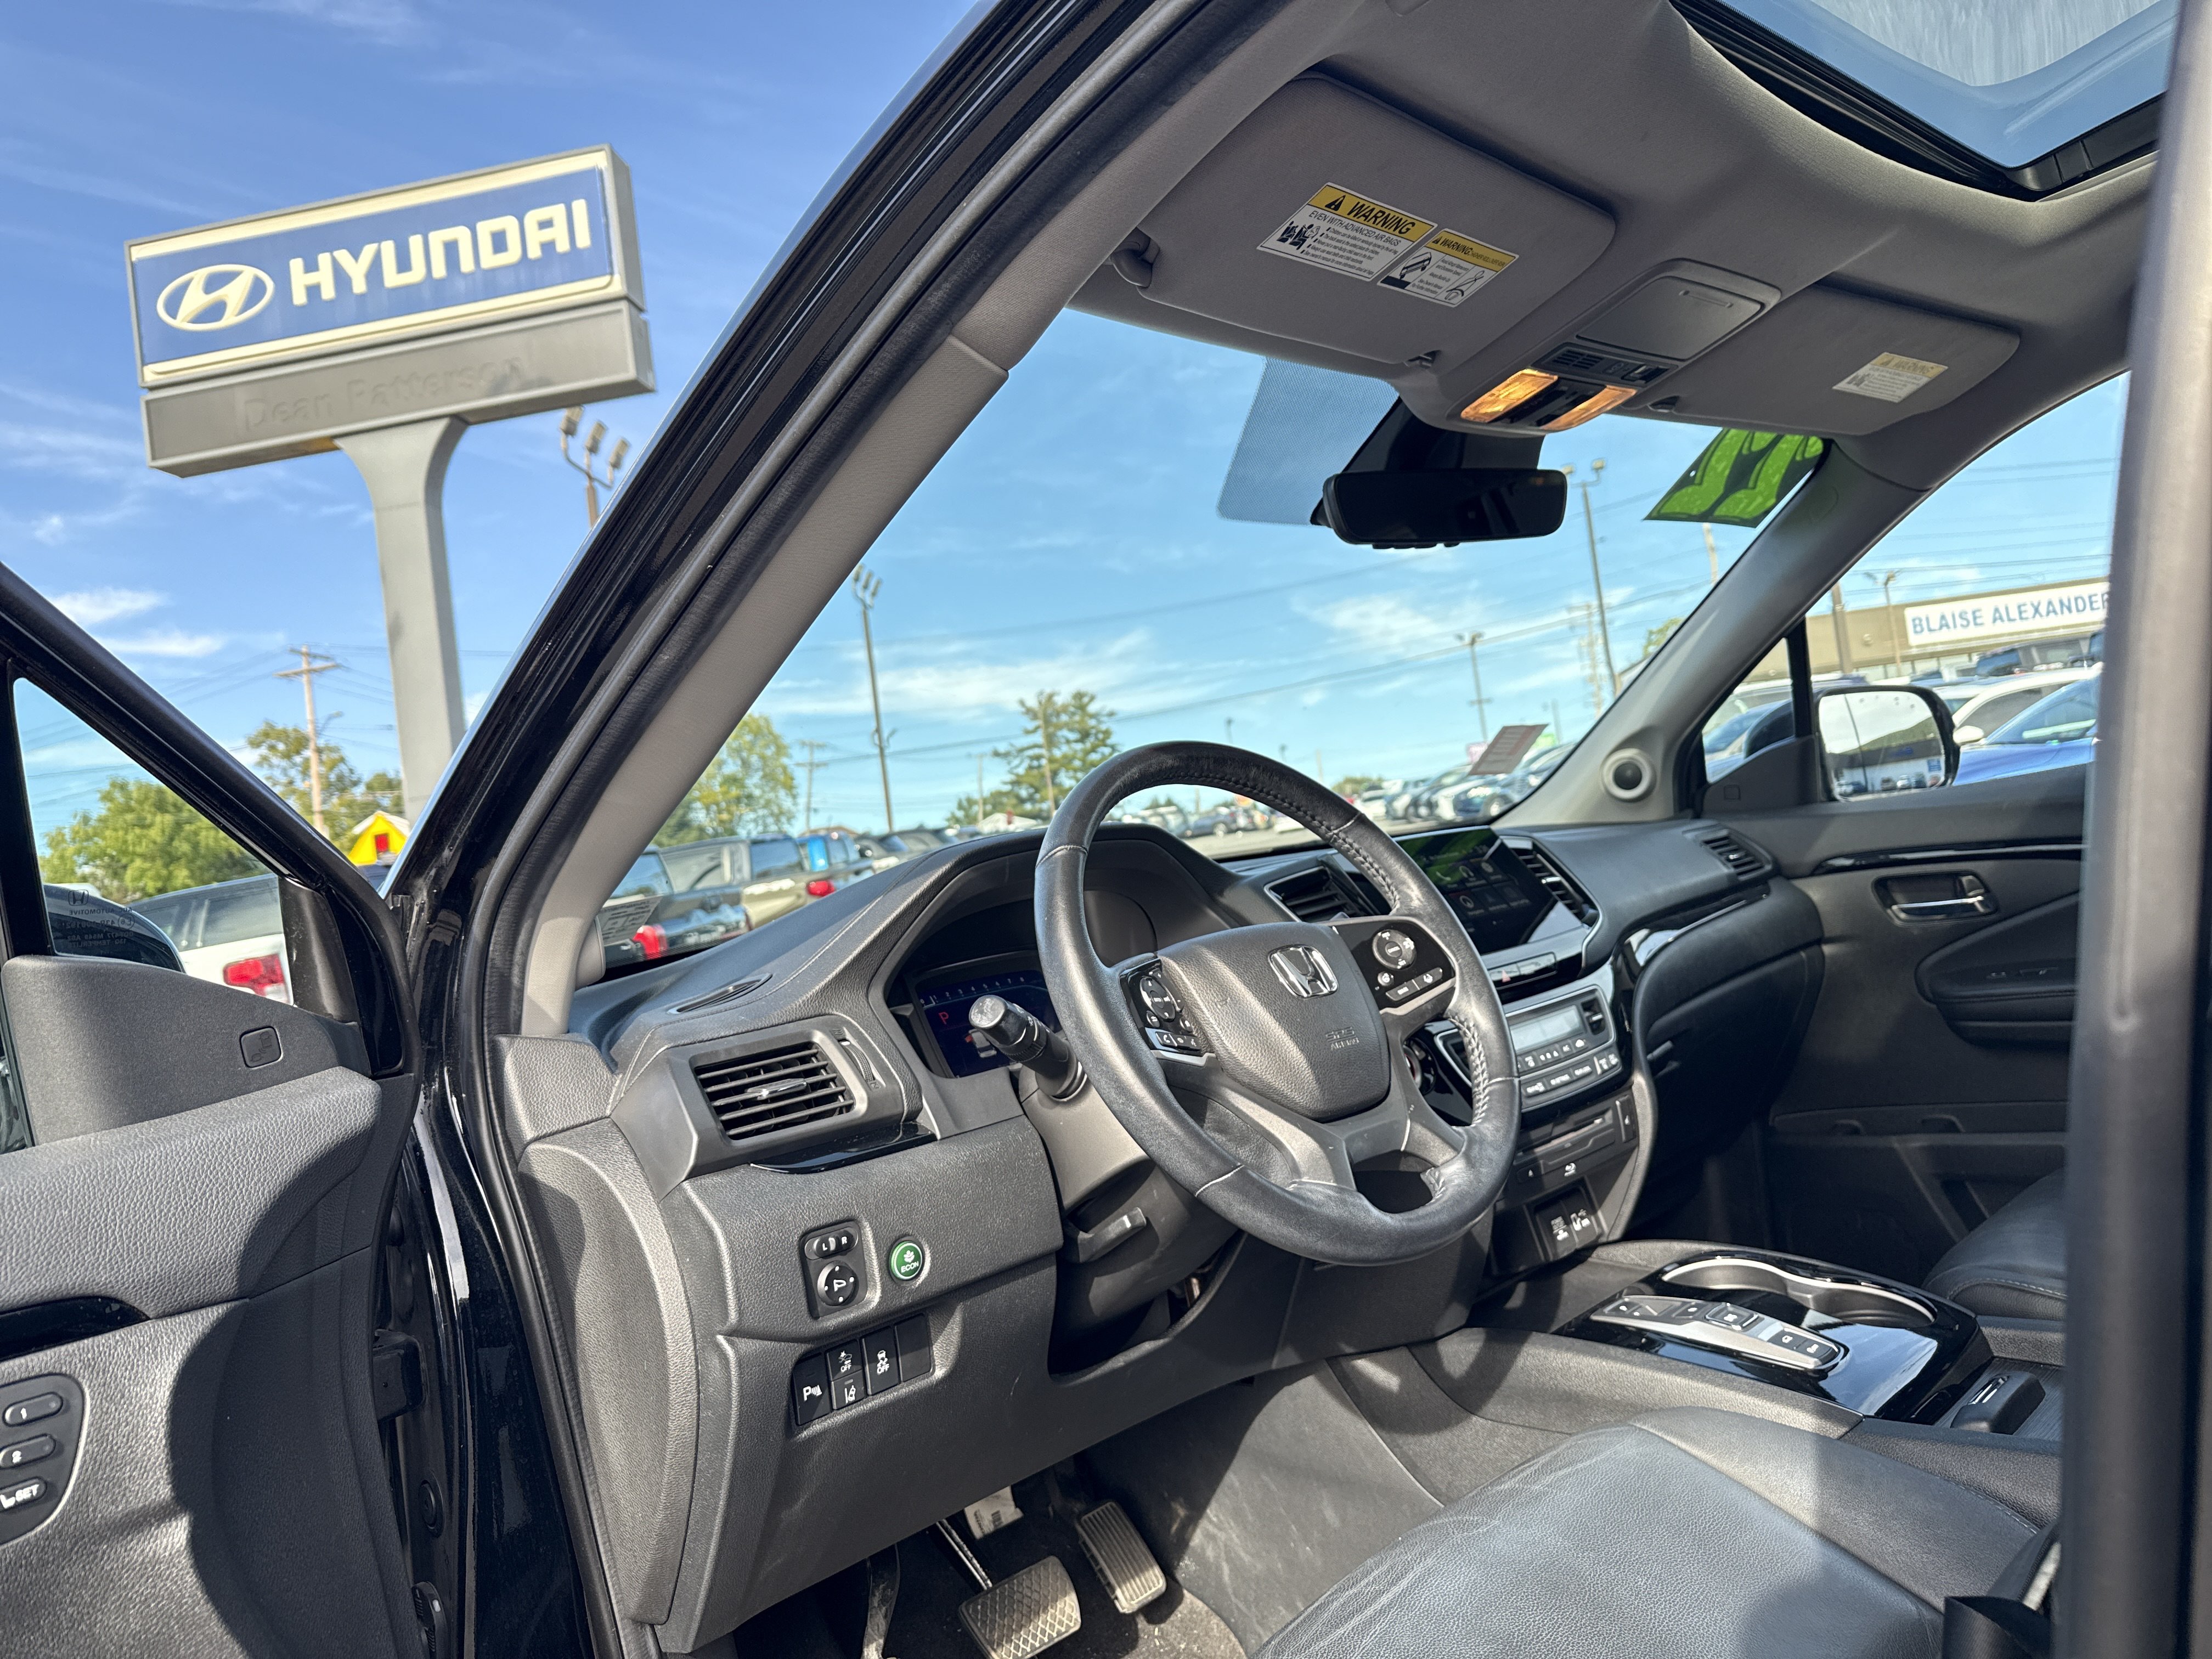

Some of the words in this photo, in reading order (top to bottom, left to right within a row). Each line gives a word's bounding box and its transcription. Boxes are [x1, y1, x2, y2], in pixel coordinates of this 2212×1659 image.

[1347, 201, 1415, 234] WARNING
[1308, 210, 1329, 222] EVEN
[1327, 217, 1344, 228] WITH
[1342, 222, 1375, 238] ADVANCED
[1372, 233, 1385, 242] AIR
[1383, 236, 1401, 246] BAGS
[290, 199, 591, 306] HYUNDAI
[347, 357, 524, 409] Patterson
[1911, 608, 1984, 635] BLAISE
[938, 1012, 949, 1025] P
[822, 1243, 828, 1251] L
[841, 1236, 848, 1245] R
[901, 1261, 919, 1273] ECON
[840, 1362, 852, 1372] OFF
[877, 1363, 889, 1374] OFF
[803, 1386, 812, 1401] P
[20, 1407, 27, 1420] 1
[12, 1450, 22, 1463] 2
[15, 1484, 40, 1502] SET
